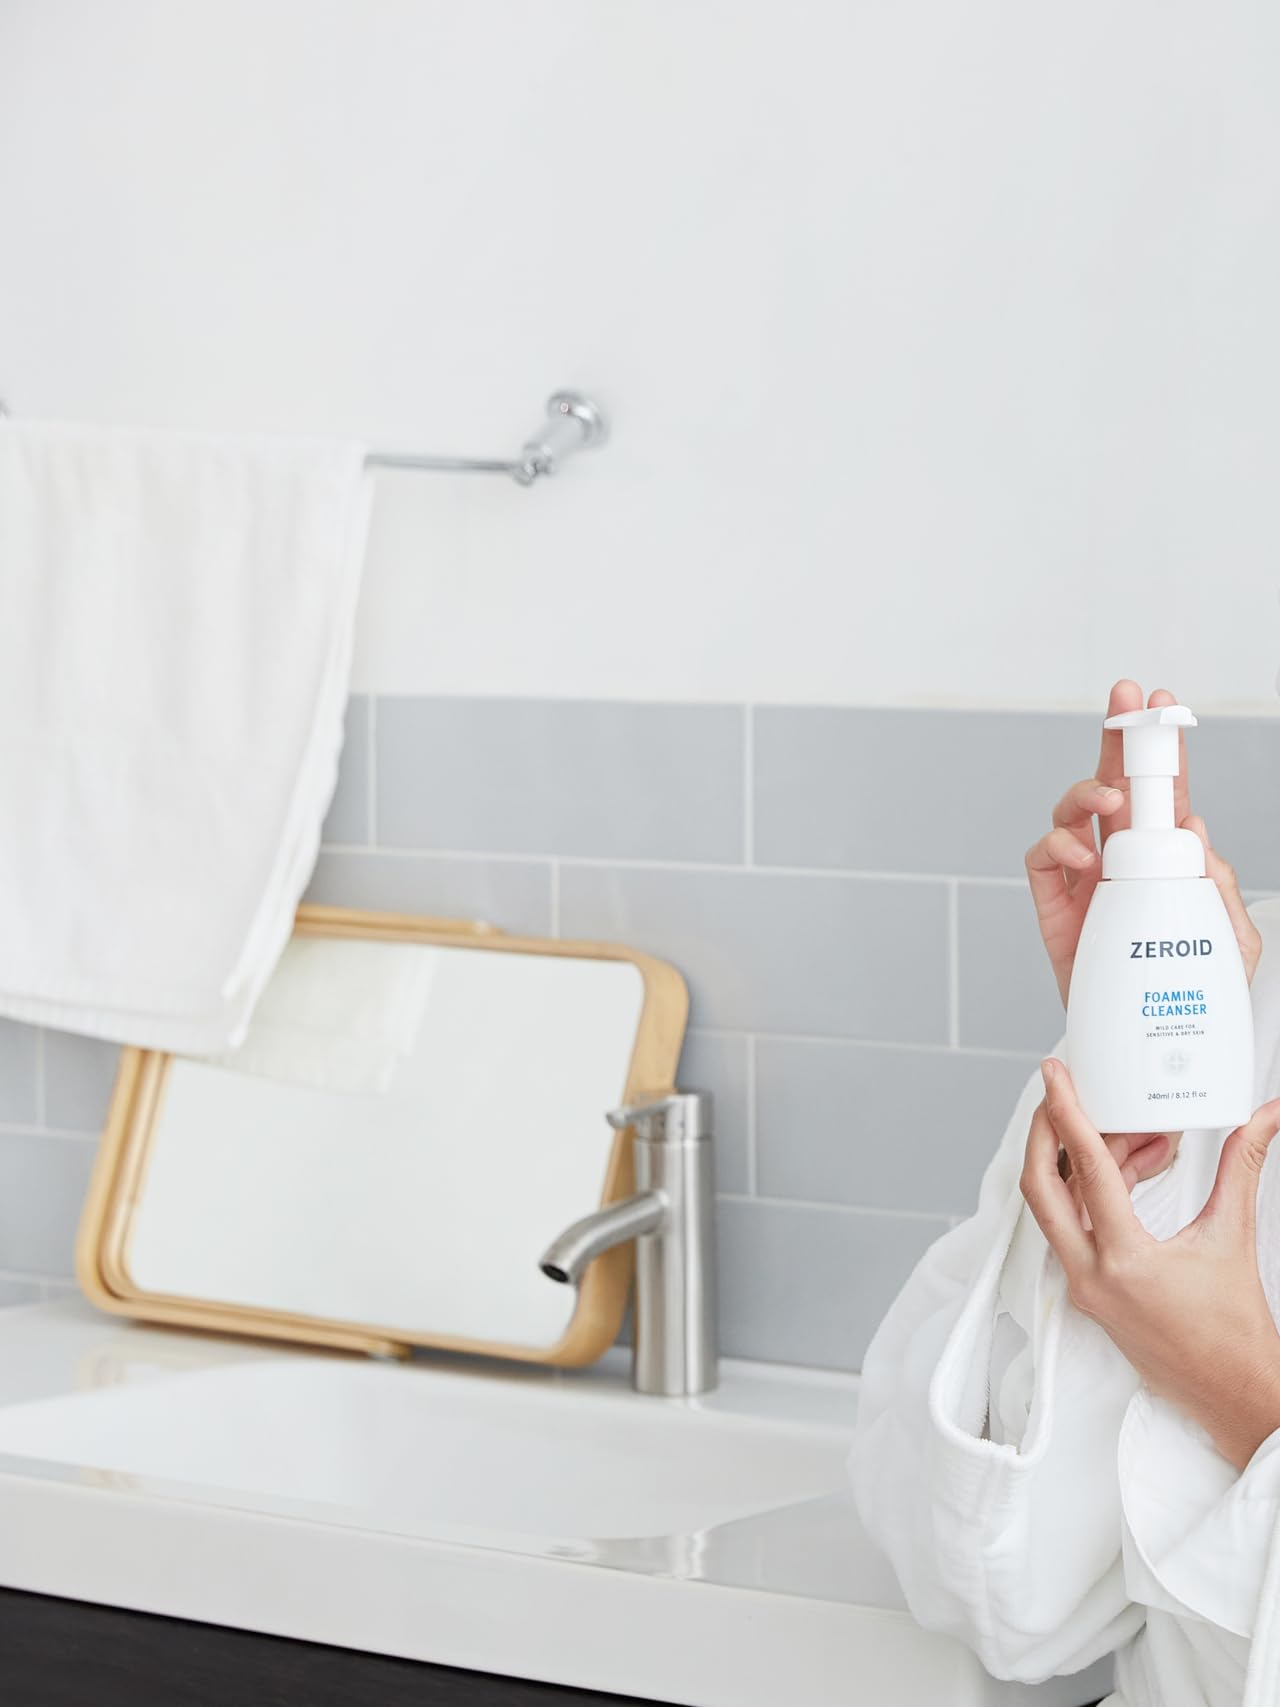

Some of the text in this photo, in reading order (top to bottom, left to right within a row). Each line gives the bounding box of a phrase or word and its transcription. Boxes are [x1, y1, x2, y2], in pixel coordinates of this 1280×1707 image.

[1130, 939, 1212, 958] ZEROID
[1144, 990, 1204, 1003] FOAMING
[1142, 1003, 1207, 1017] CLEANSER
[1147, 1092, 1170, 1101] 240ml
[1175, 1091, 1190, 1099] 8.12
